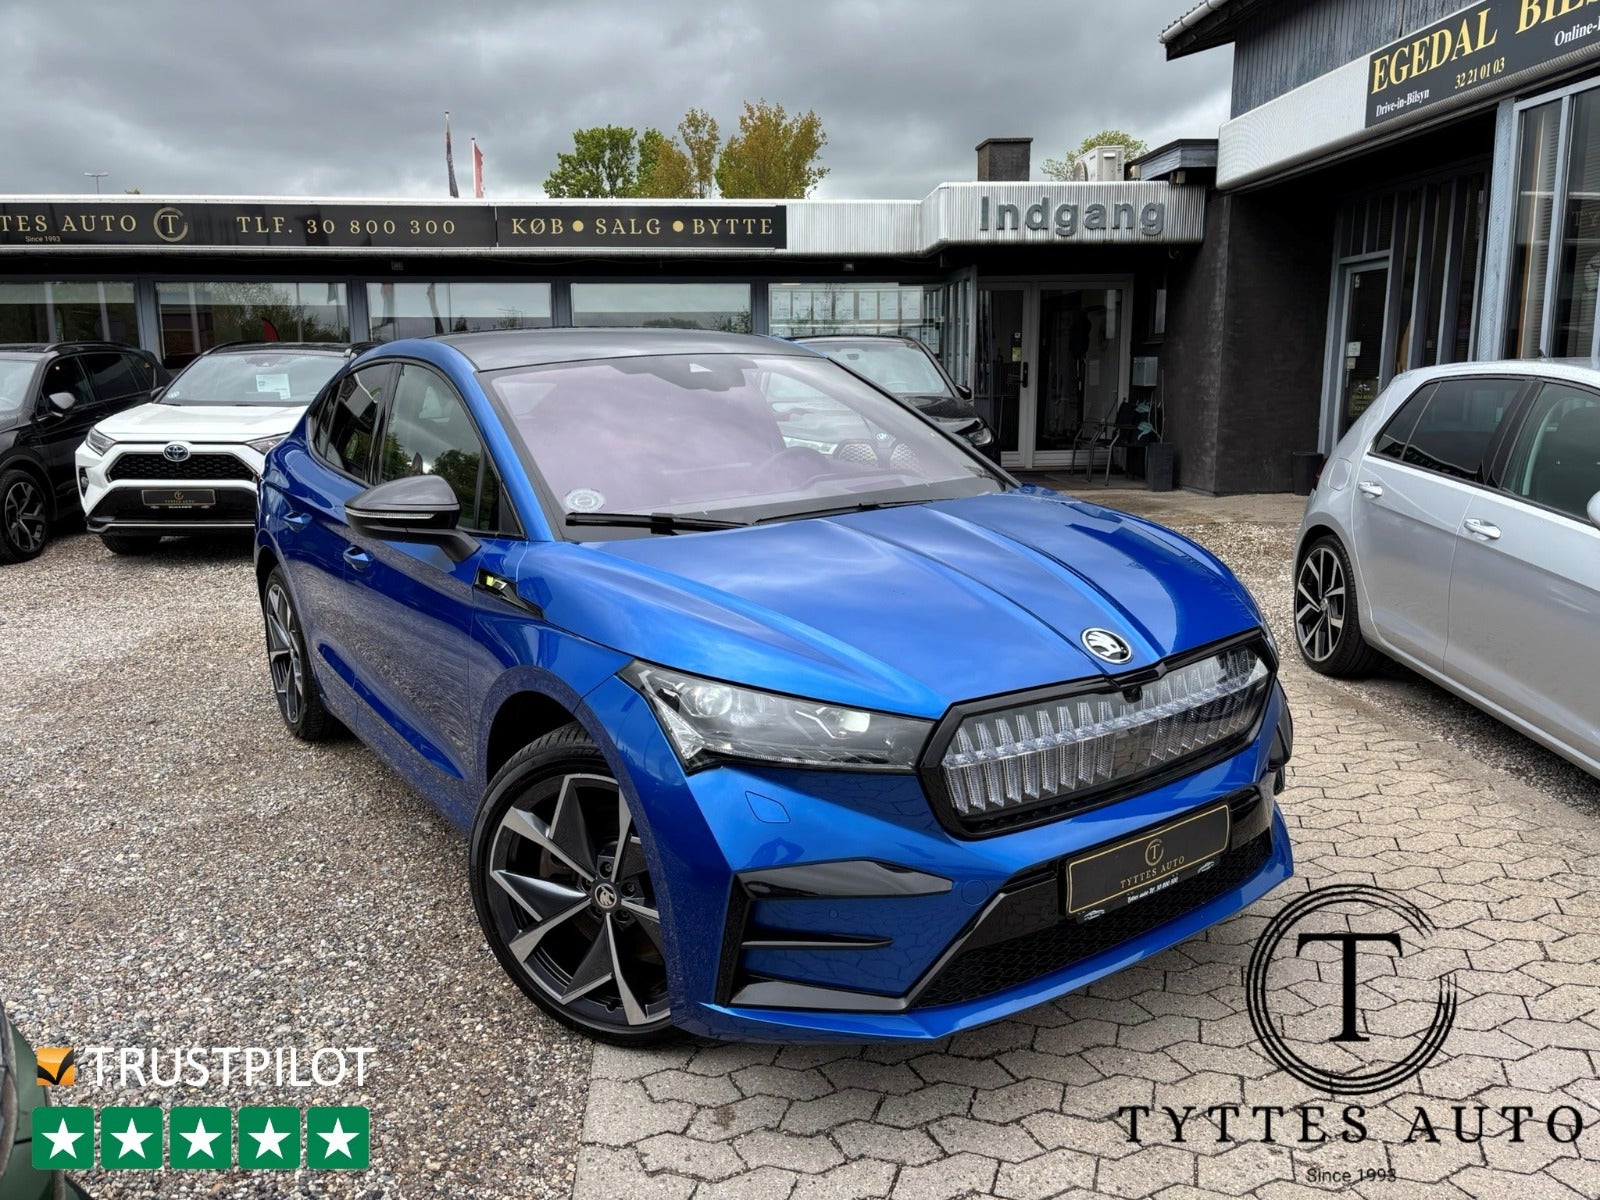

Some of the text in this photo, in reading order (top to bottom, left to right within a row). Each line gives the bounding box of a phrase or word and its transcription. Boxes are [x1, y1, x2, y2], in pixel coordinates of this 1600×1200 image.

[1554, 15, 1600, 47] Online-
[1371, 8, 1498, 94] EGEDAL
[1454, 57, 1505, 90] 32 21 01 03
[1375, 89, 1430, 118] Drive-in-Bilsyn
[0, 214, 137, 232] TES AUTO
[236, 216, 456, 235] TLF. 30 800 300
[511, 218, 773, 236] KØB SALG BYTTE
[979, 196, 1166, 237] Indgang
[1120, 855, 1185, 889] TYTTES AUTO
